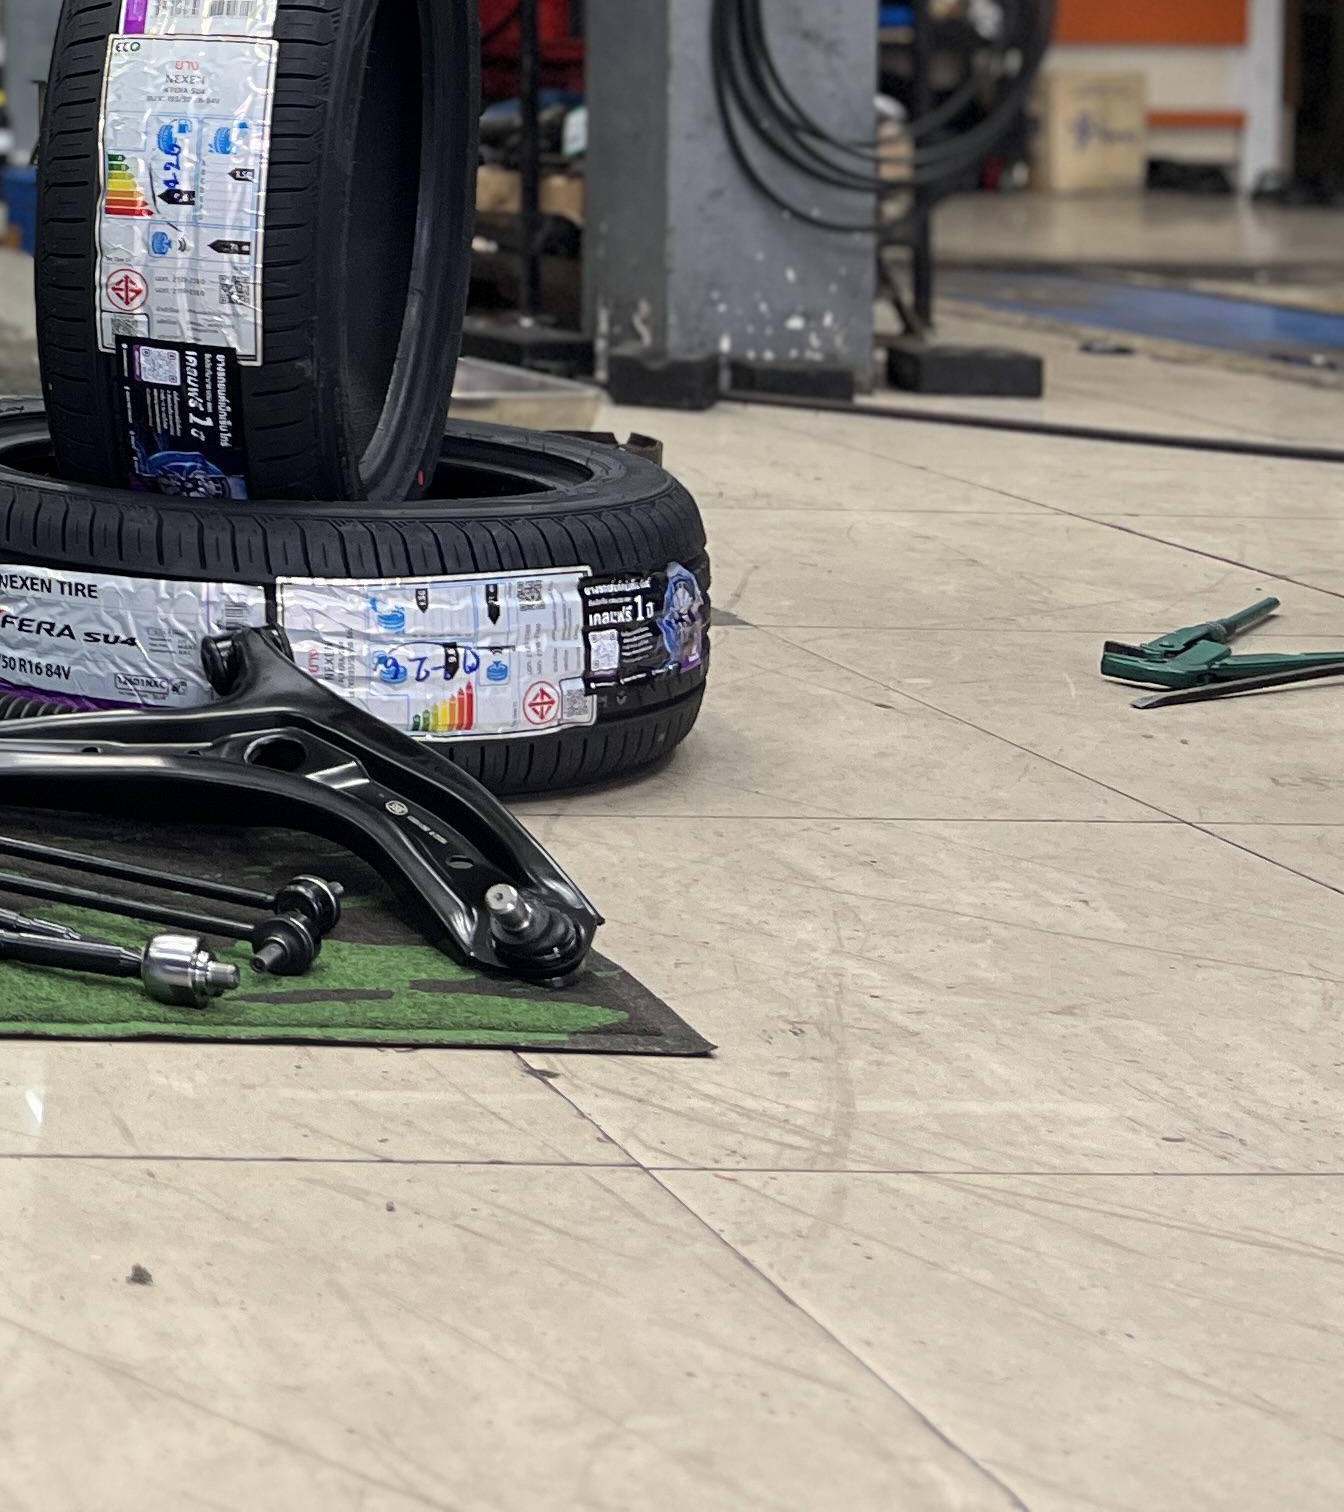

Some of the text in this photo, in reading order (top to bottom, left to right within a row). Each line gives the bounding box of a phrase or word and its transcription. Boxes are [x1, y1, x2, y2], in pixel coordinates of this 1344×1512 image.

[115, 41, 141, 53] ECO
[165, 74, 205, 85] NEXEN
[57, 580, 98, 599] TIRE
[632, 596, 644, 622] 1
[83, 631, 137, 647] SU4
[18, 656, 43, 676] R16
[45, 662, 72, 681] 84V
